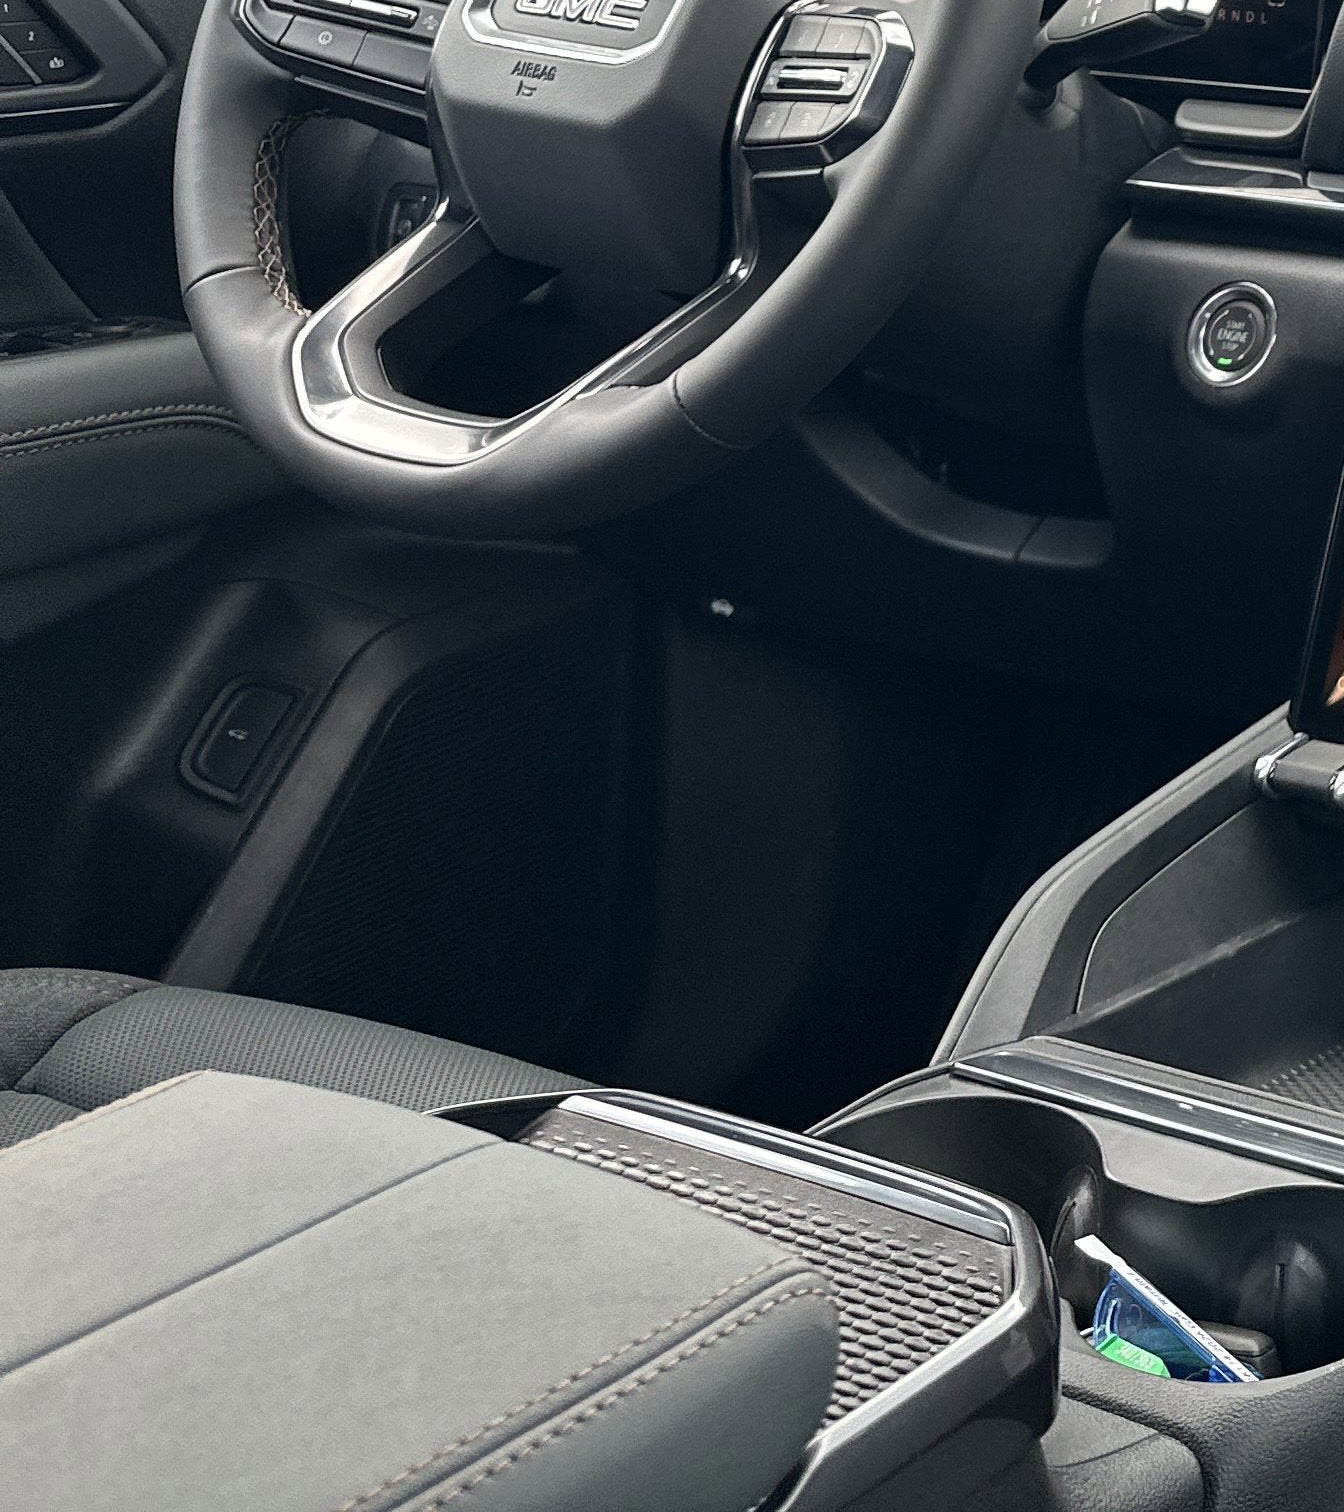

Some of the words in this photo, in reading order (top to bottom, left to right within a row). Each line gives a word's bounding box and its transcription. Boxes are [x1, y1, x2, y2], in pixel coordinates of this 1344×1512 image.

[1231, 10, 1240, 22] N
[1245, 11, 1255, 23] D
[1260, 13, 1267, 25] L
[28, 31, 35, 42] 2
[511, 60, 558, 81] AIRBAG
